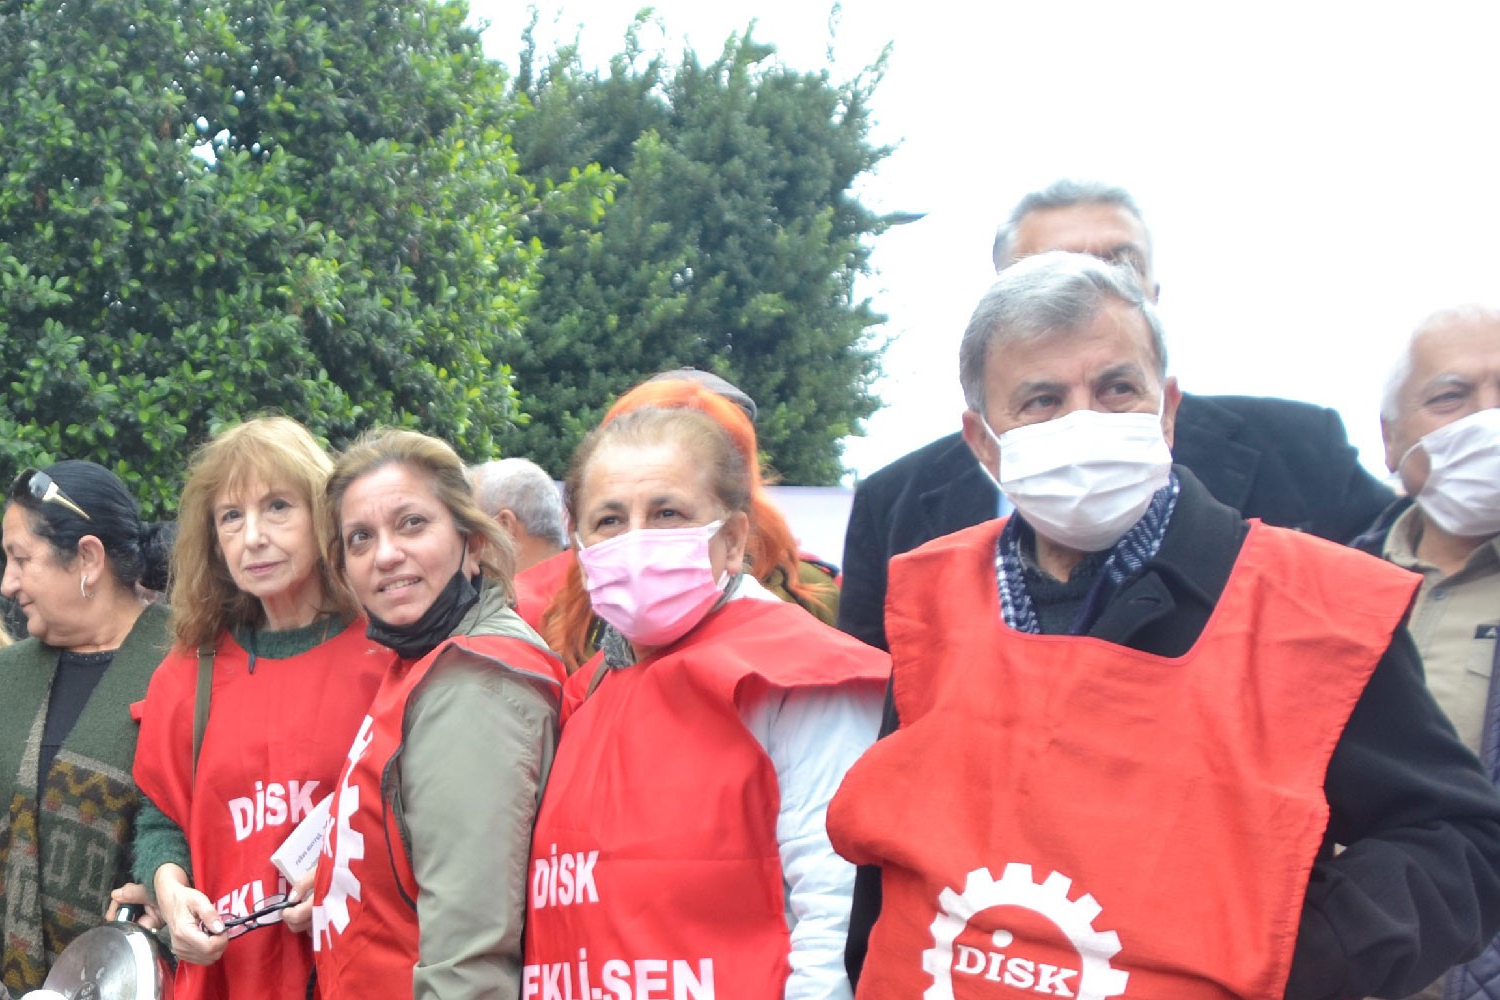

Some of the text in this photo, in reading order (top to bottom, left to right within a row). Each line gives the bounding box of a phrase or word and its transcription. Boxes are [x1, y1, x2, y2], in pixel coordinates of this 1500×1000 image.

[228, 779, 320, 842] DİSK
[533, 843, 600, 909] DİSK
[954, 929, 1078, 998] DİSK
